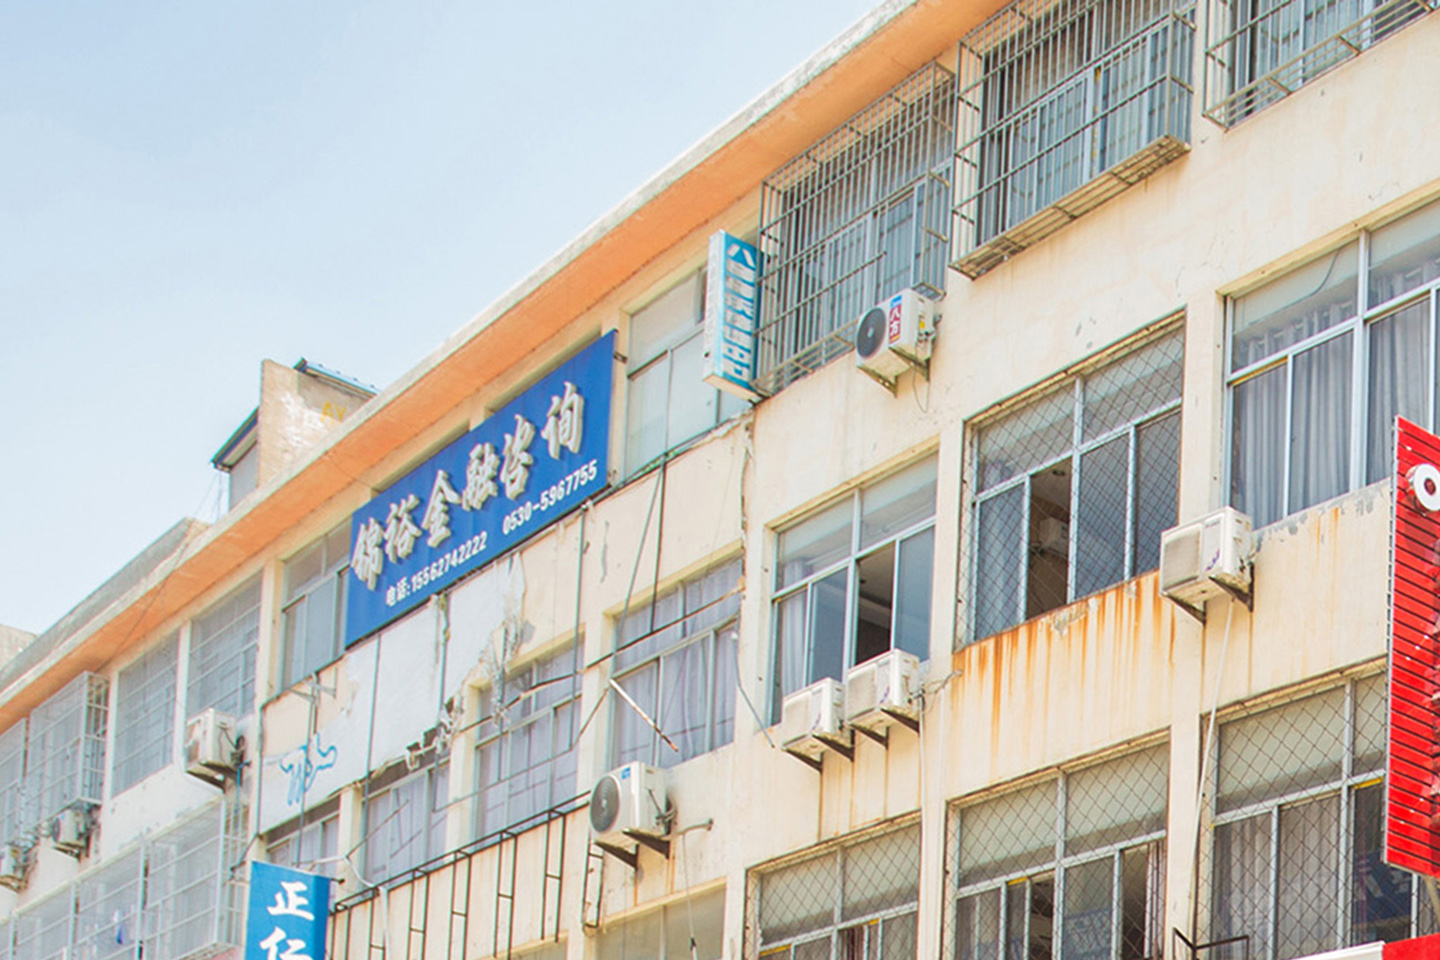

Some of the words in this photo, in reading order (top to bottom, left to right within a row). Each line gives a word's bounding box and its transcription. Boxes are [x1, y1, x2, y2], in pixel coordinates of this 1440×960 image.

[350, 381, 585, 592] 锦裕金融咨询
[502, 459, 598, 535] 0530-5967755
